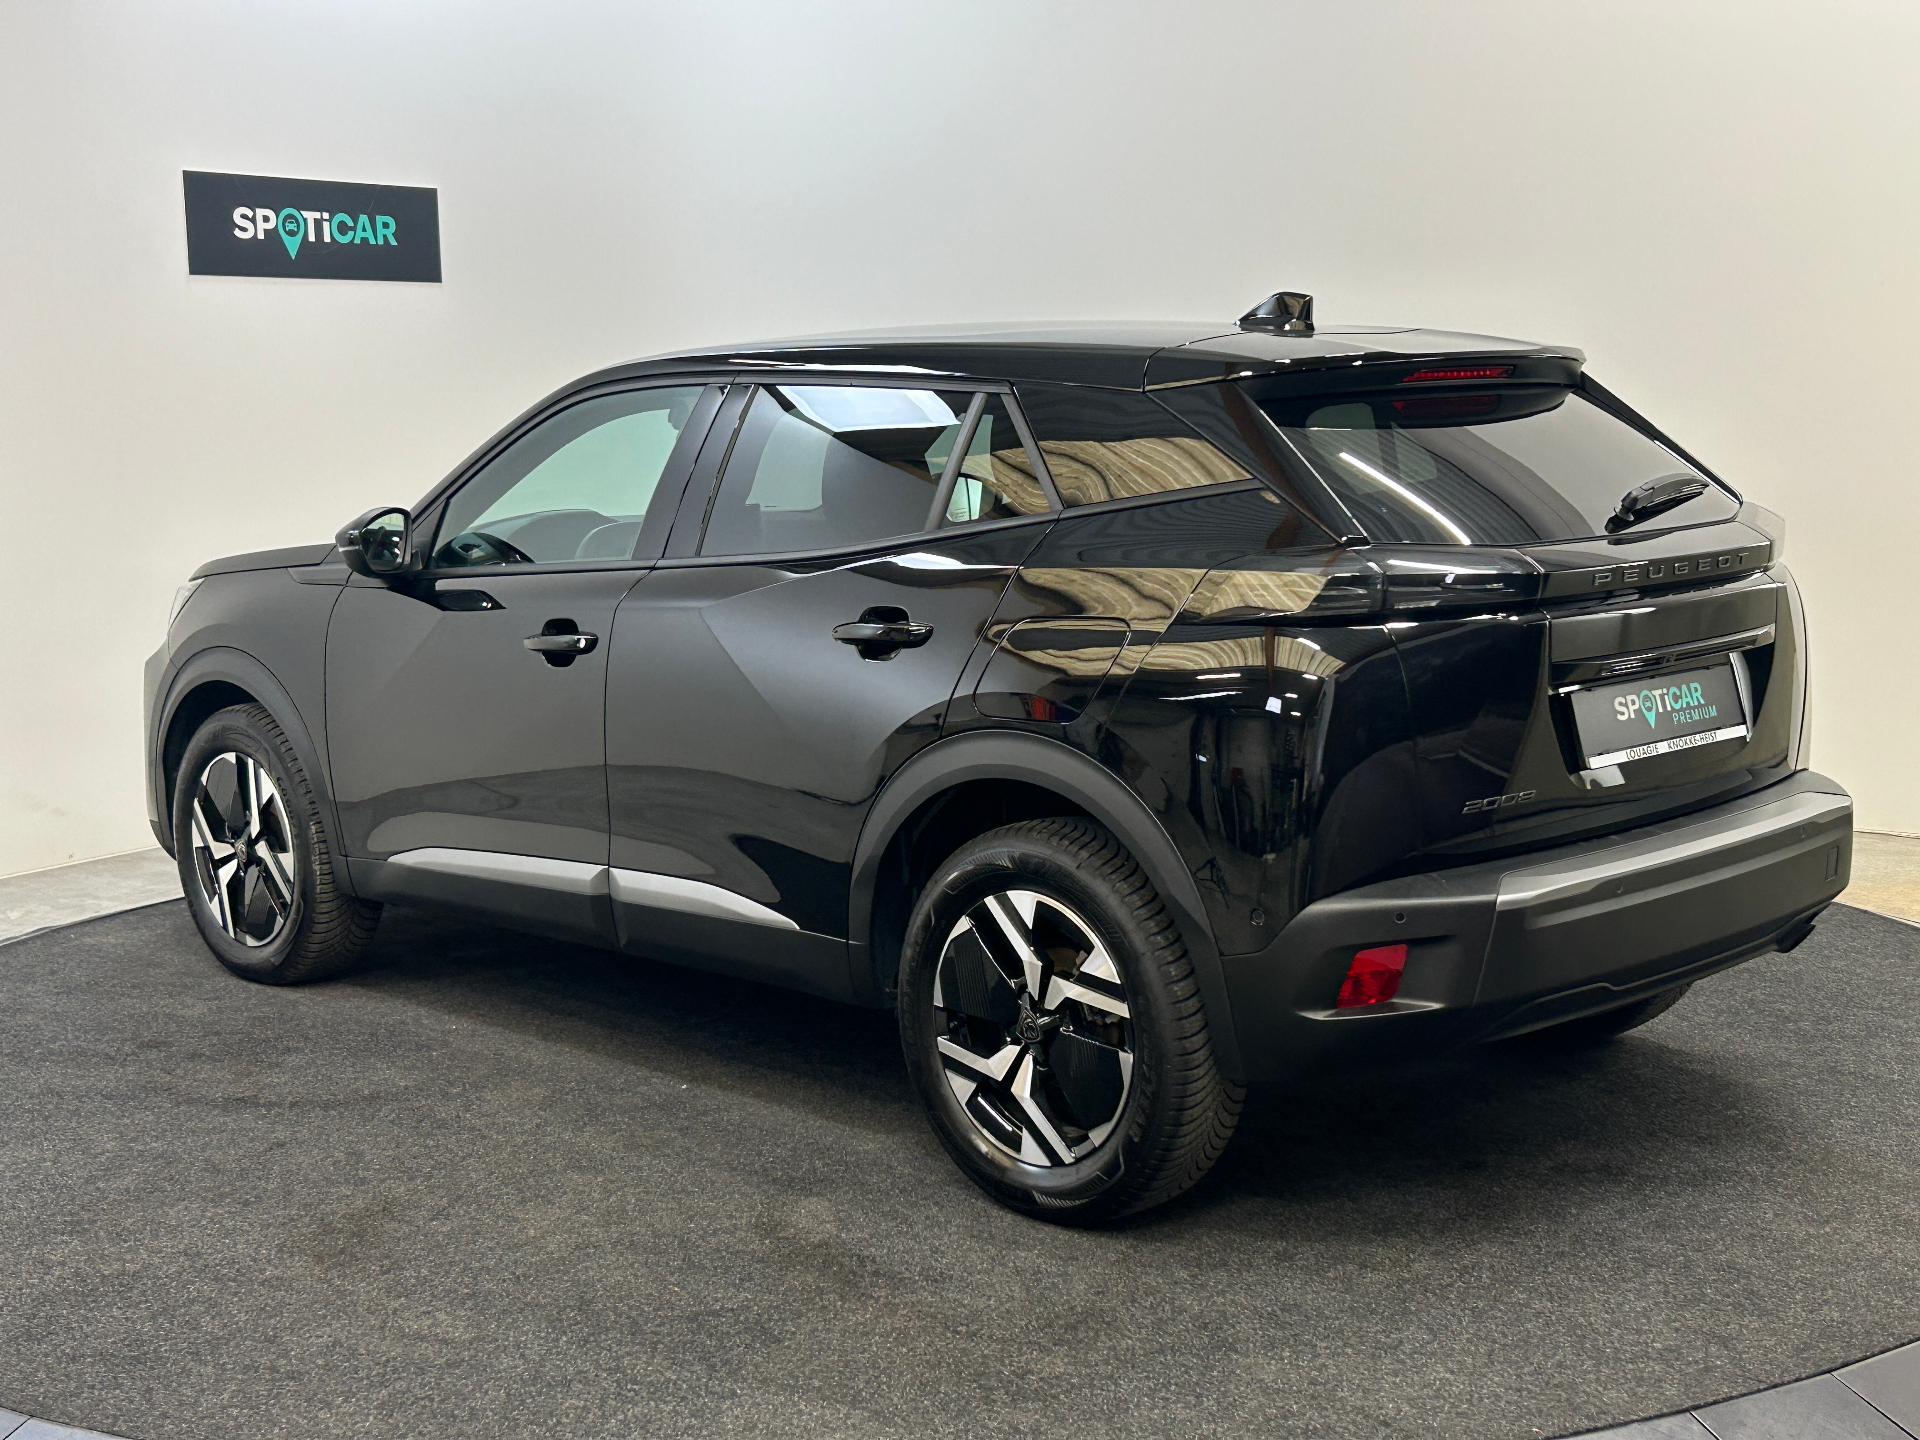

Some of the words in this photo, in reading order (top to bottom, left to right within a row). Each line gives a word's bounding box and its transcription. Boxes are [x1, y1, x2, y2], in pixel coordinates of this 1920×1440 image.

[1592, 552, 1749, 587] PEUGEOT
[1672, 704, 1718, 725] PREMIUM
[1625, 743, 1660, 760] LOUAGIE
[1461, 789, 1537, 814] 2008
